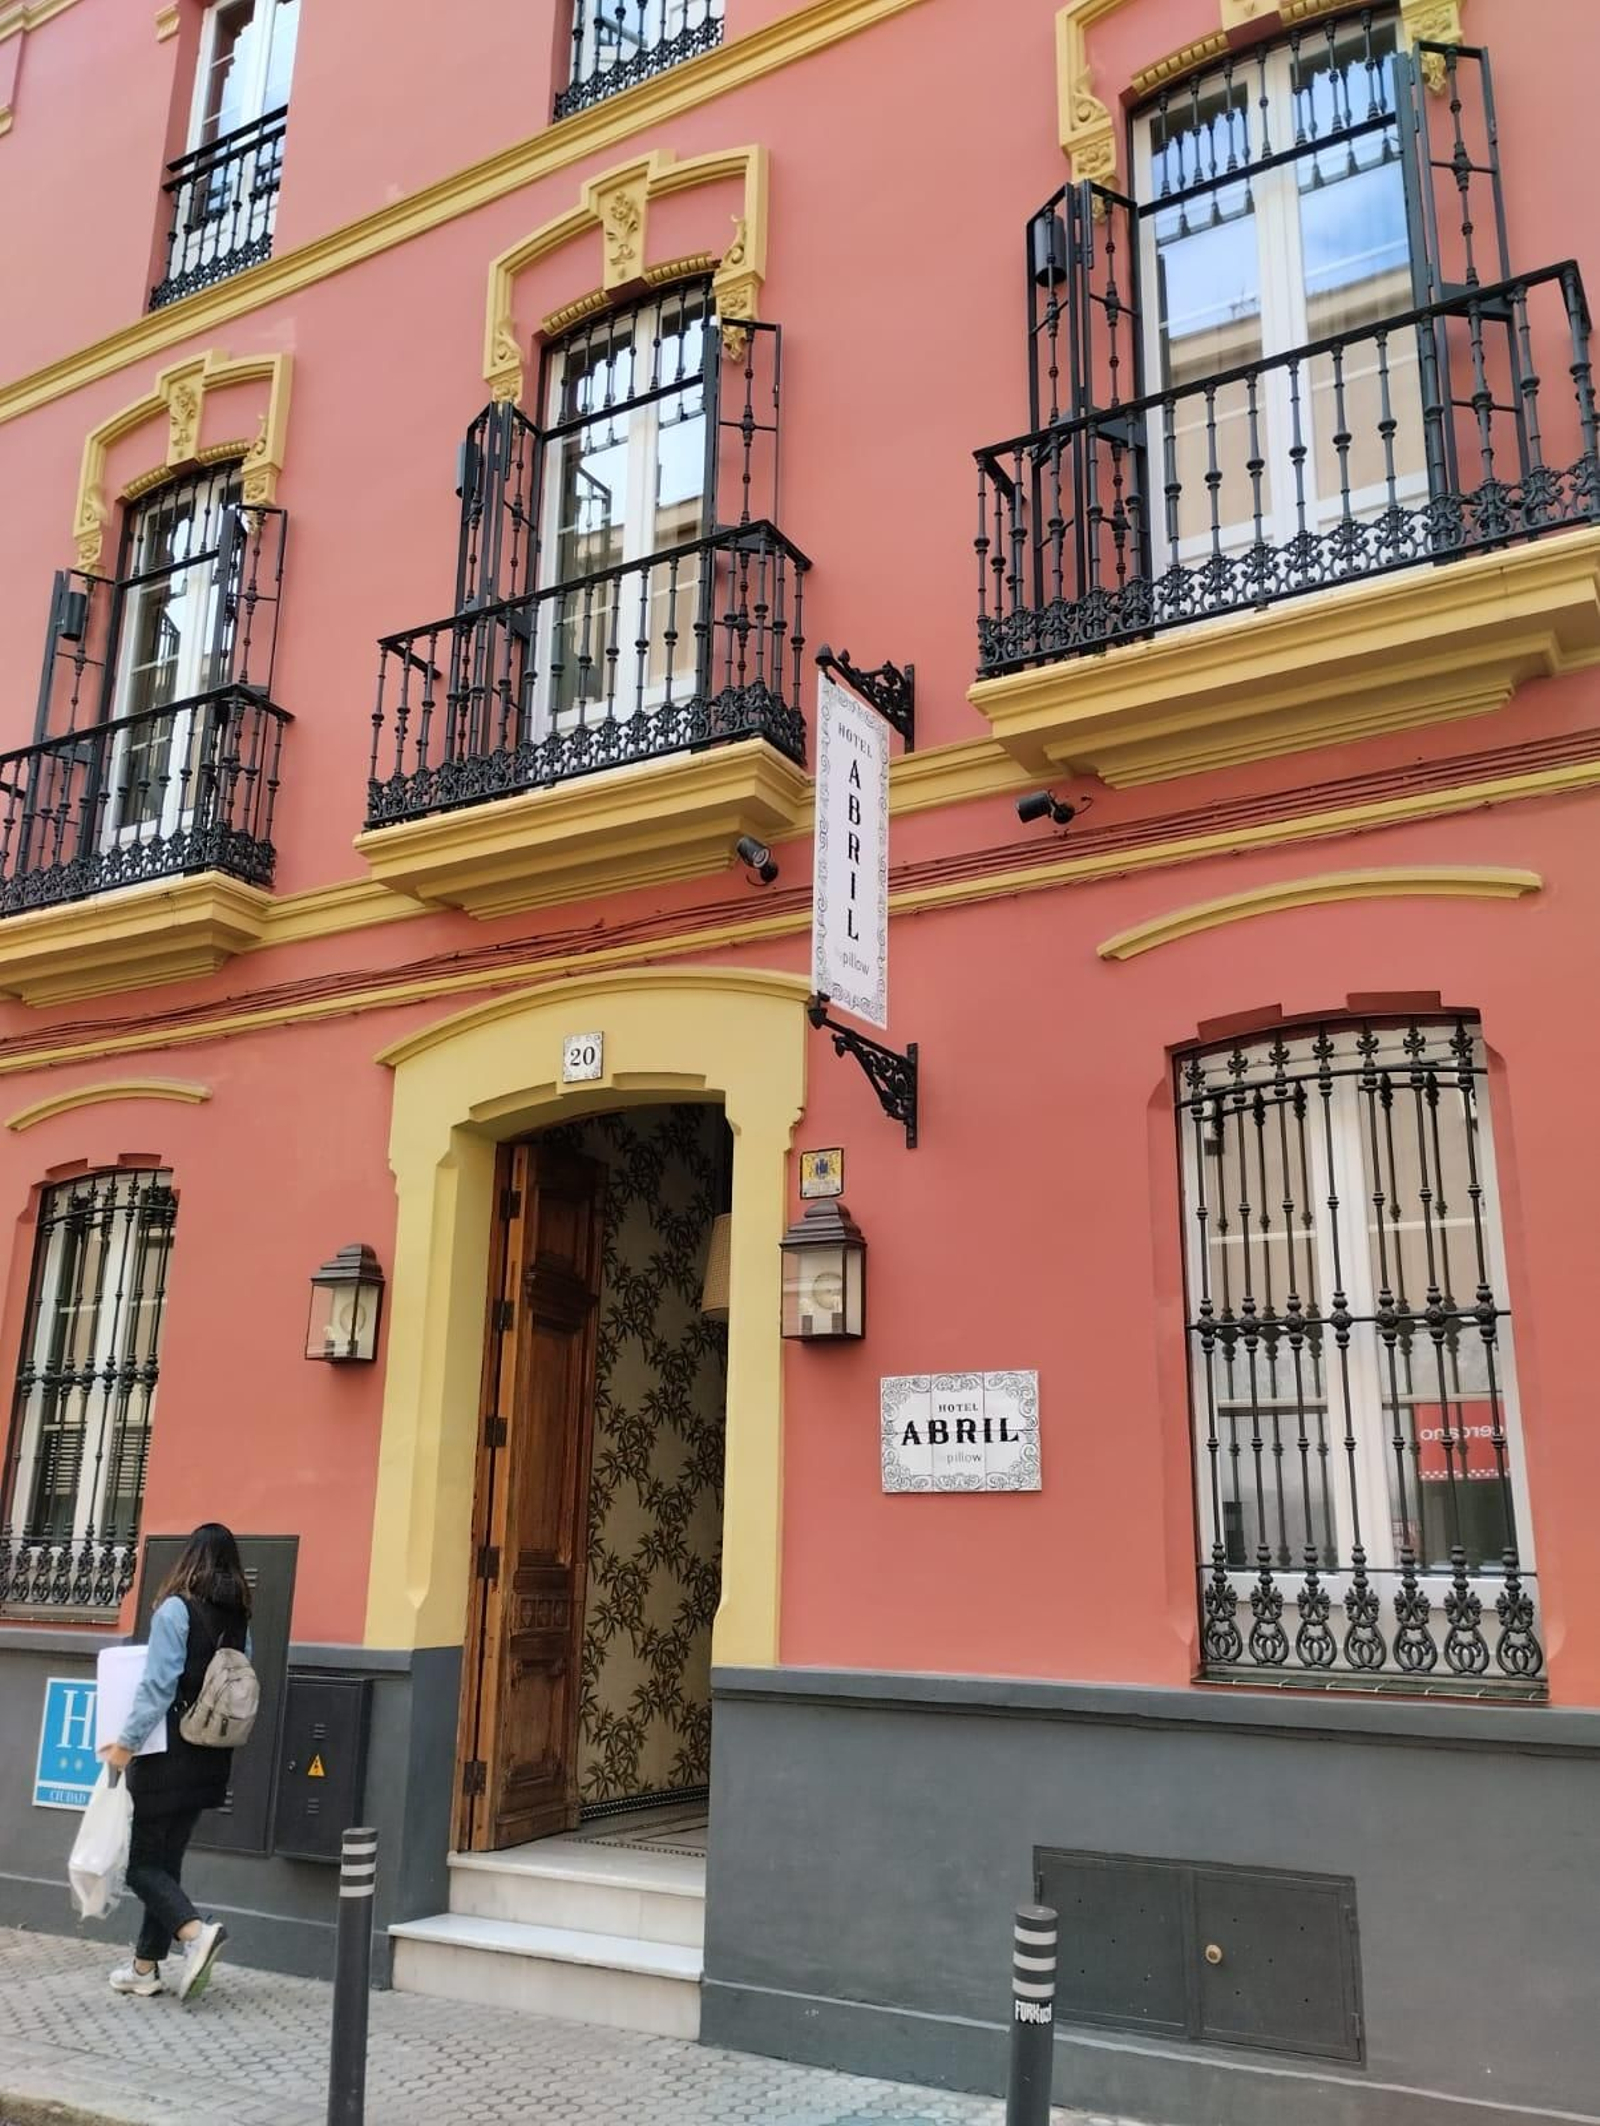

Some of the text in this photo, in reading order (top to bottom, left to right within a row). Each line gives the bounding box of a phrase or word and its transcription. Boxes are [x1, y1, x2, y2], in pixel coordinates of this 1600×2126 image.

[838, 722, 873, 759] HOTEL
[848, 758, 863, 942] ABRIL
[843, 951, 870, 976] pillow
[570, 1046, 596, 1067] 20
[938, 1403, 978, 1413] HOTEL
[901, 1417, 1019, 1446] ABRIL
[946, 1451, 982, 1465] pillow
[56, 1689, 97, 1751] H
